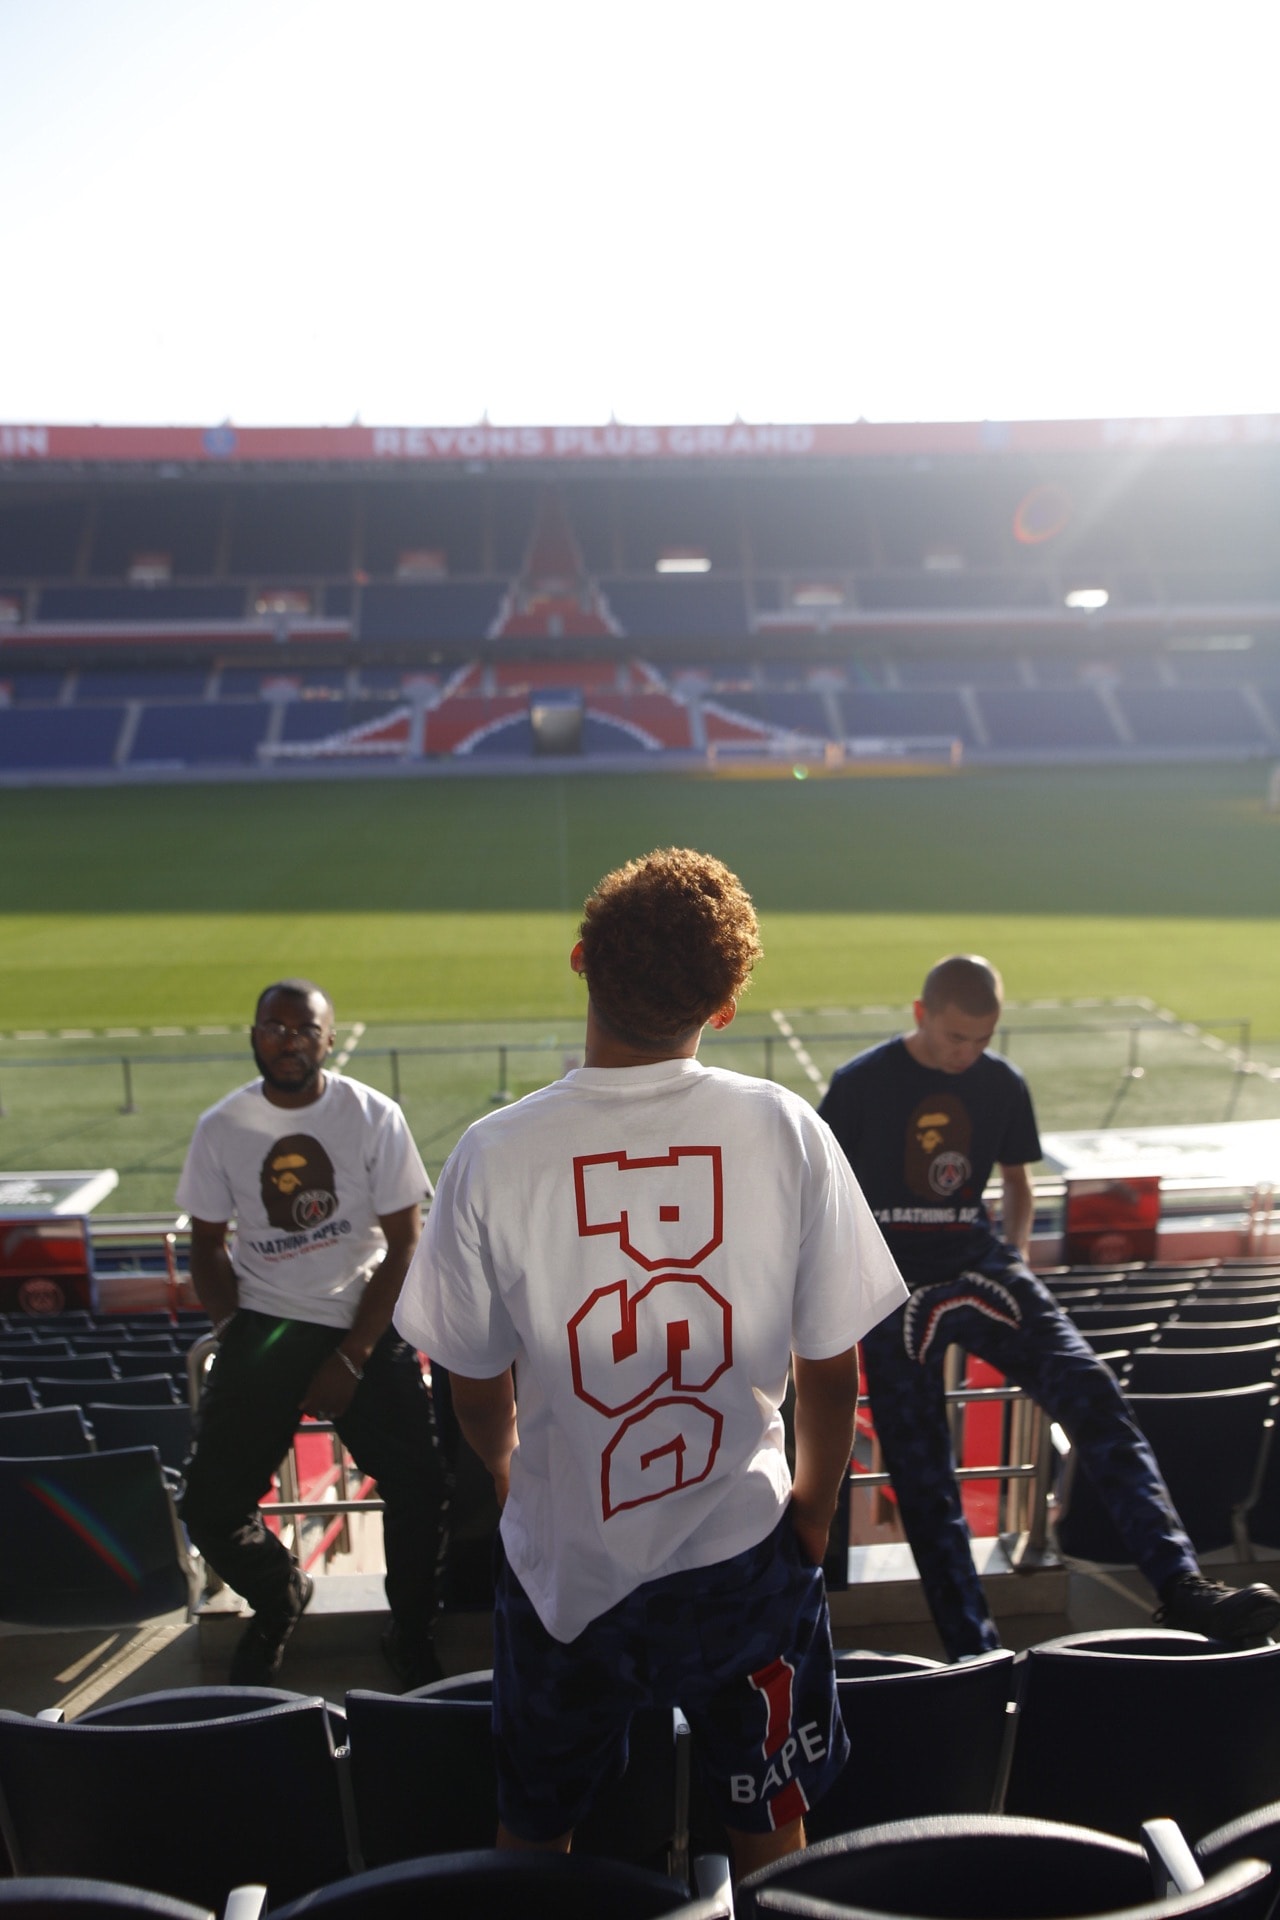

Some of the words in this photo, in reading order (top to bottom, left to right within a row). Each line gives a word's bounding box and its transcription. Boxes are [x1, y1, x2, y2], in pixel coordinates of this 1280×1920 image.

[554, 428, 661, 454] PLUS
[668, 426, 815, 453] GRAND
[892, 1207, 956, 1223] BATHING
[958, 1207, 979, 1223] AP
[567, 1146, 733, 1521] PSG
[731, 1721, 826, 1804] BAPE
